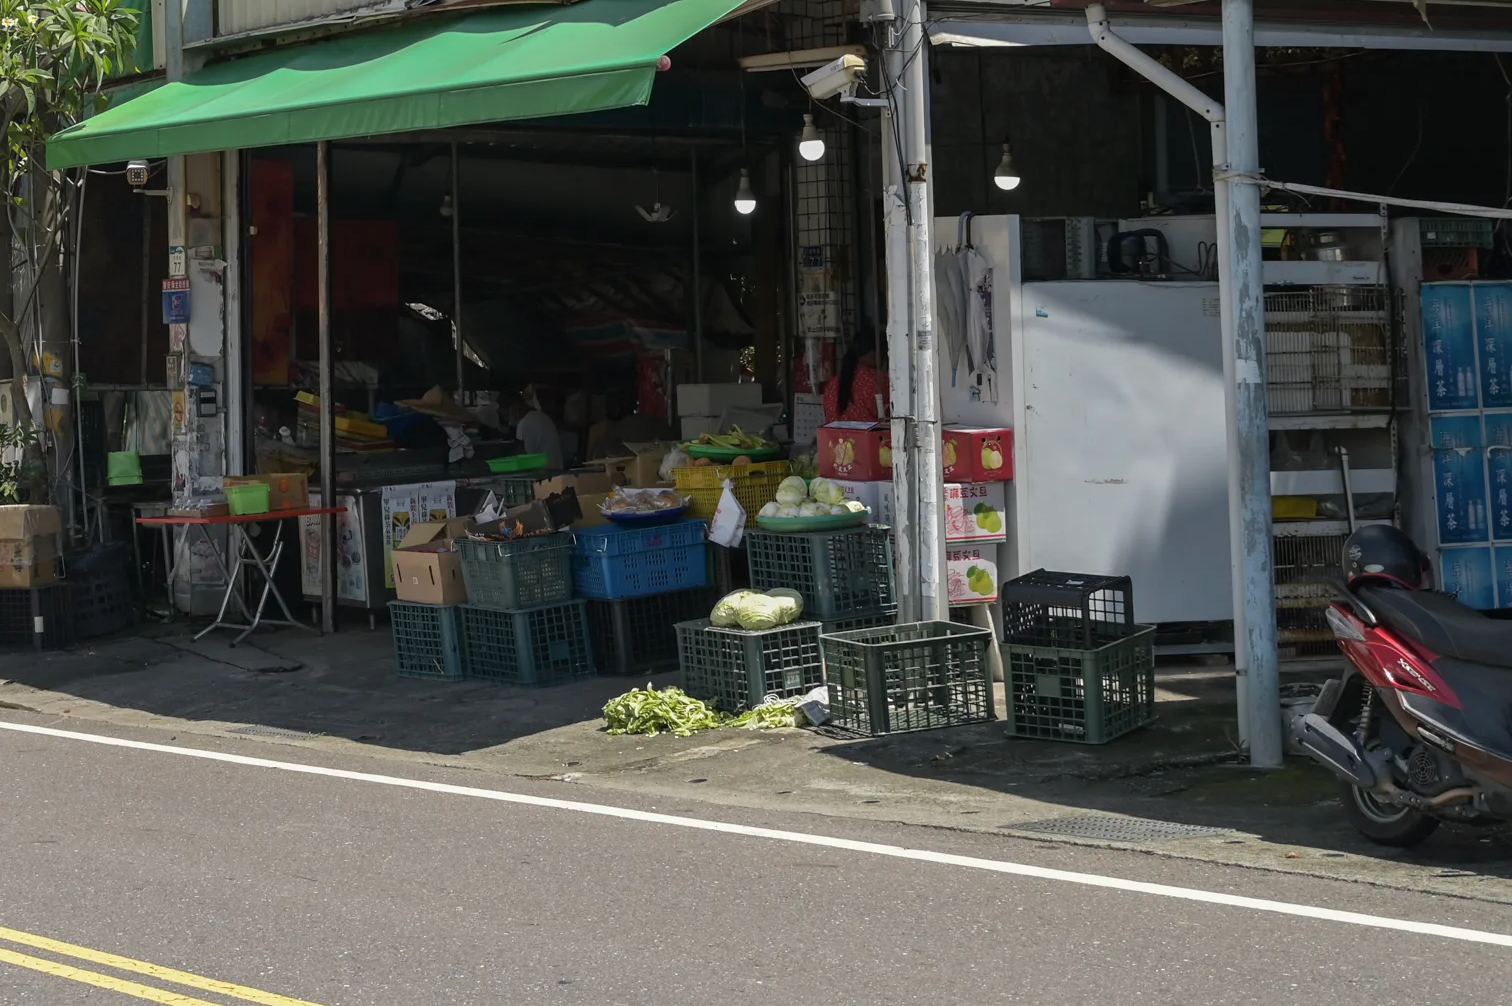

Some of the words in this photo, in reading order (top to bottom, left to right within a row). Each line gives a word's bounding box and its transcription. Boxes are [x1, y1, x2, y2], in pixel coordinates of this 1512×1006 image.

[173, 262, 182, 273] 77
[1429, 297, 1447, 398] 海洋深層茶
[1482, 296, 1500, 396] 海洋深層茶
